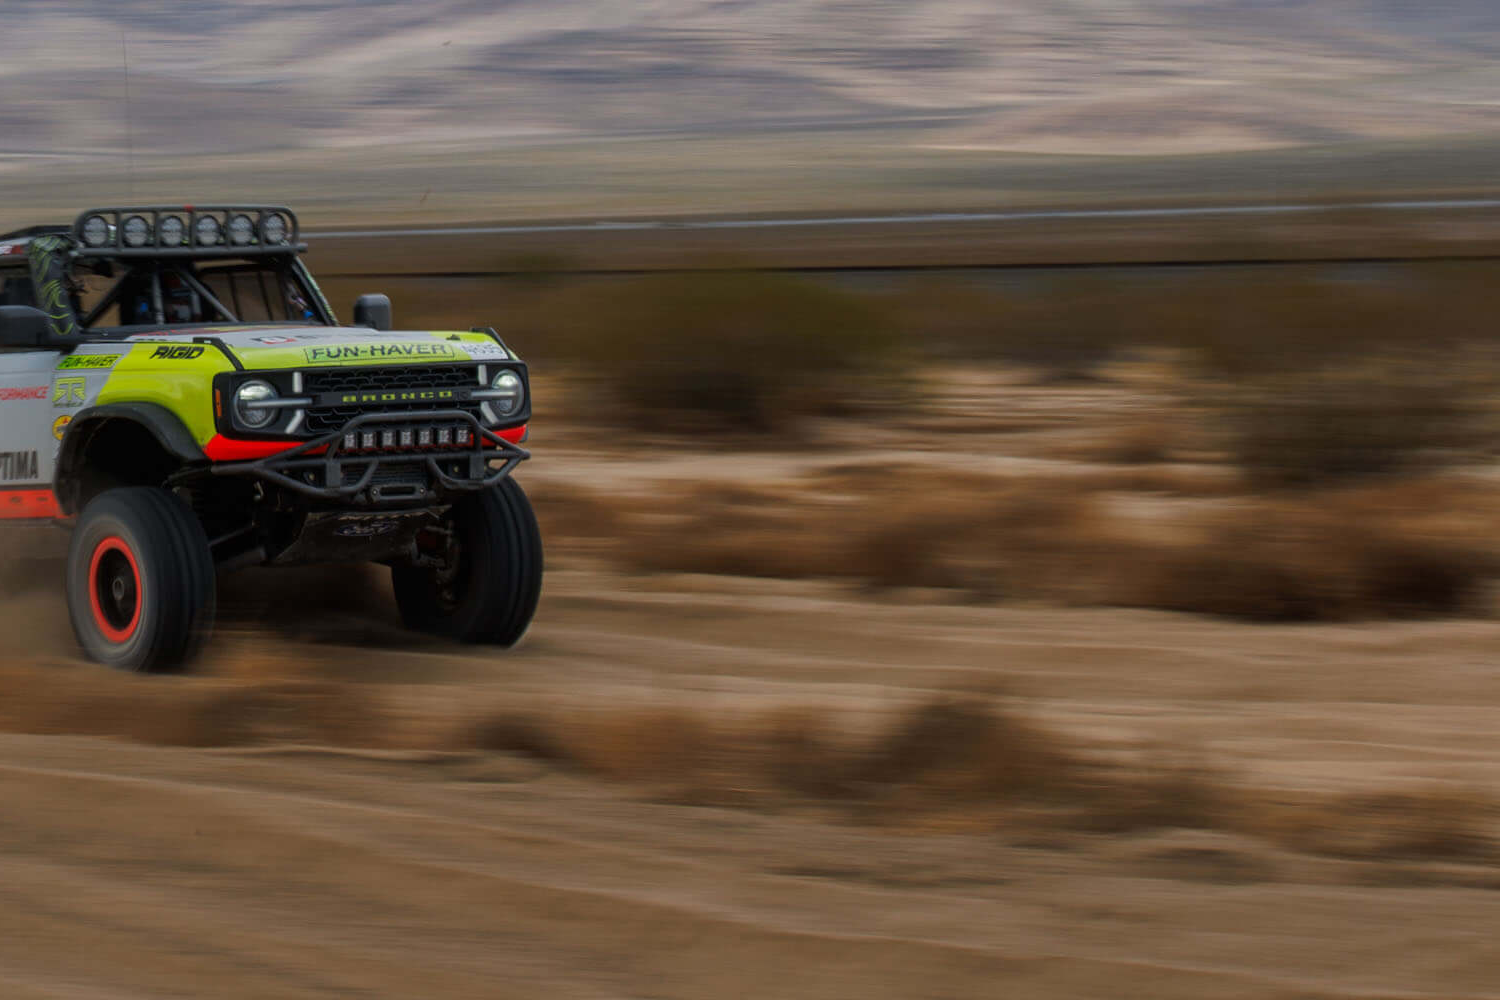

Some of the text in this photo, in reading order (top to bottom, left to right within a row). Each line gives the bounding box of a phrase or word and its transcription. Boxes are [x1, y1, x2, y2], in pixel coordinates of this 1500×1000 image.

[149, 345, 205, 360] RIGID
[311, 343, 448, 360] FUN-HAVER
[61, 355, 120, 369] FUN-HAVER
[342, 390, 453, 403] BRONCO
